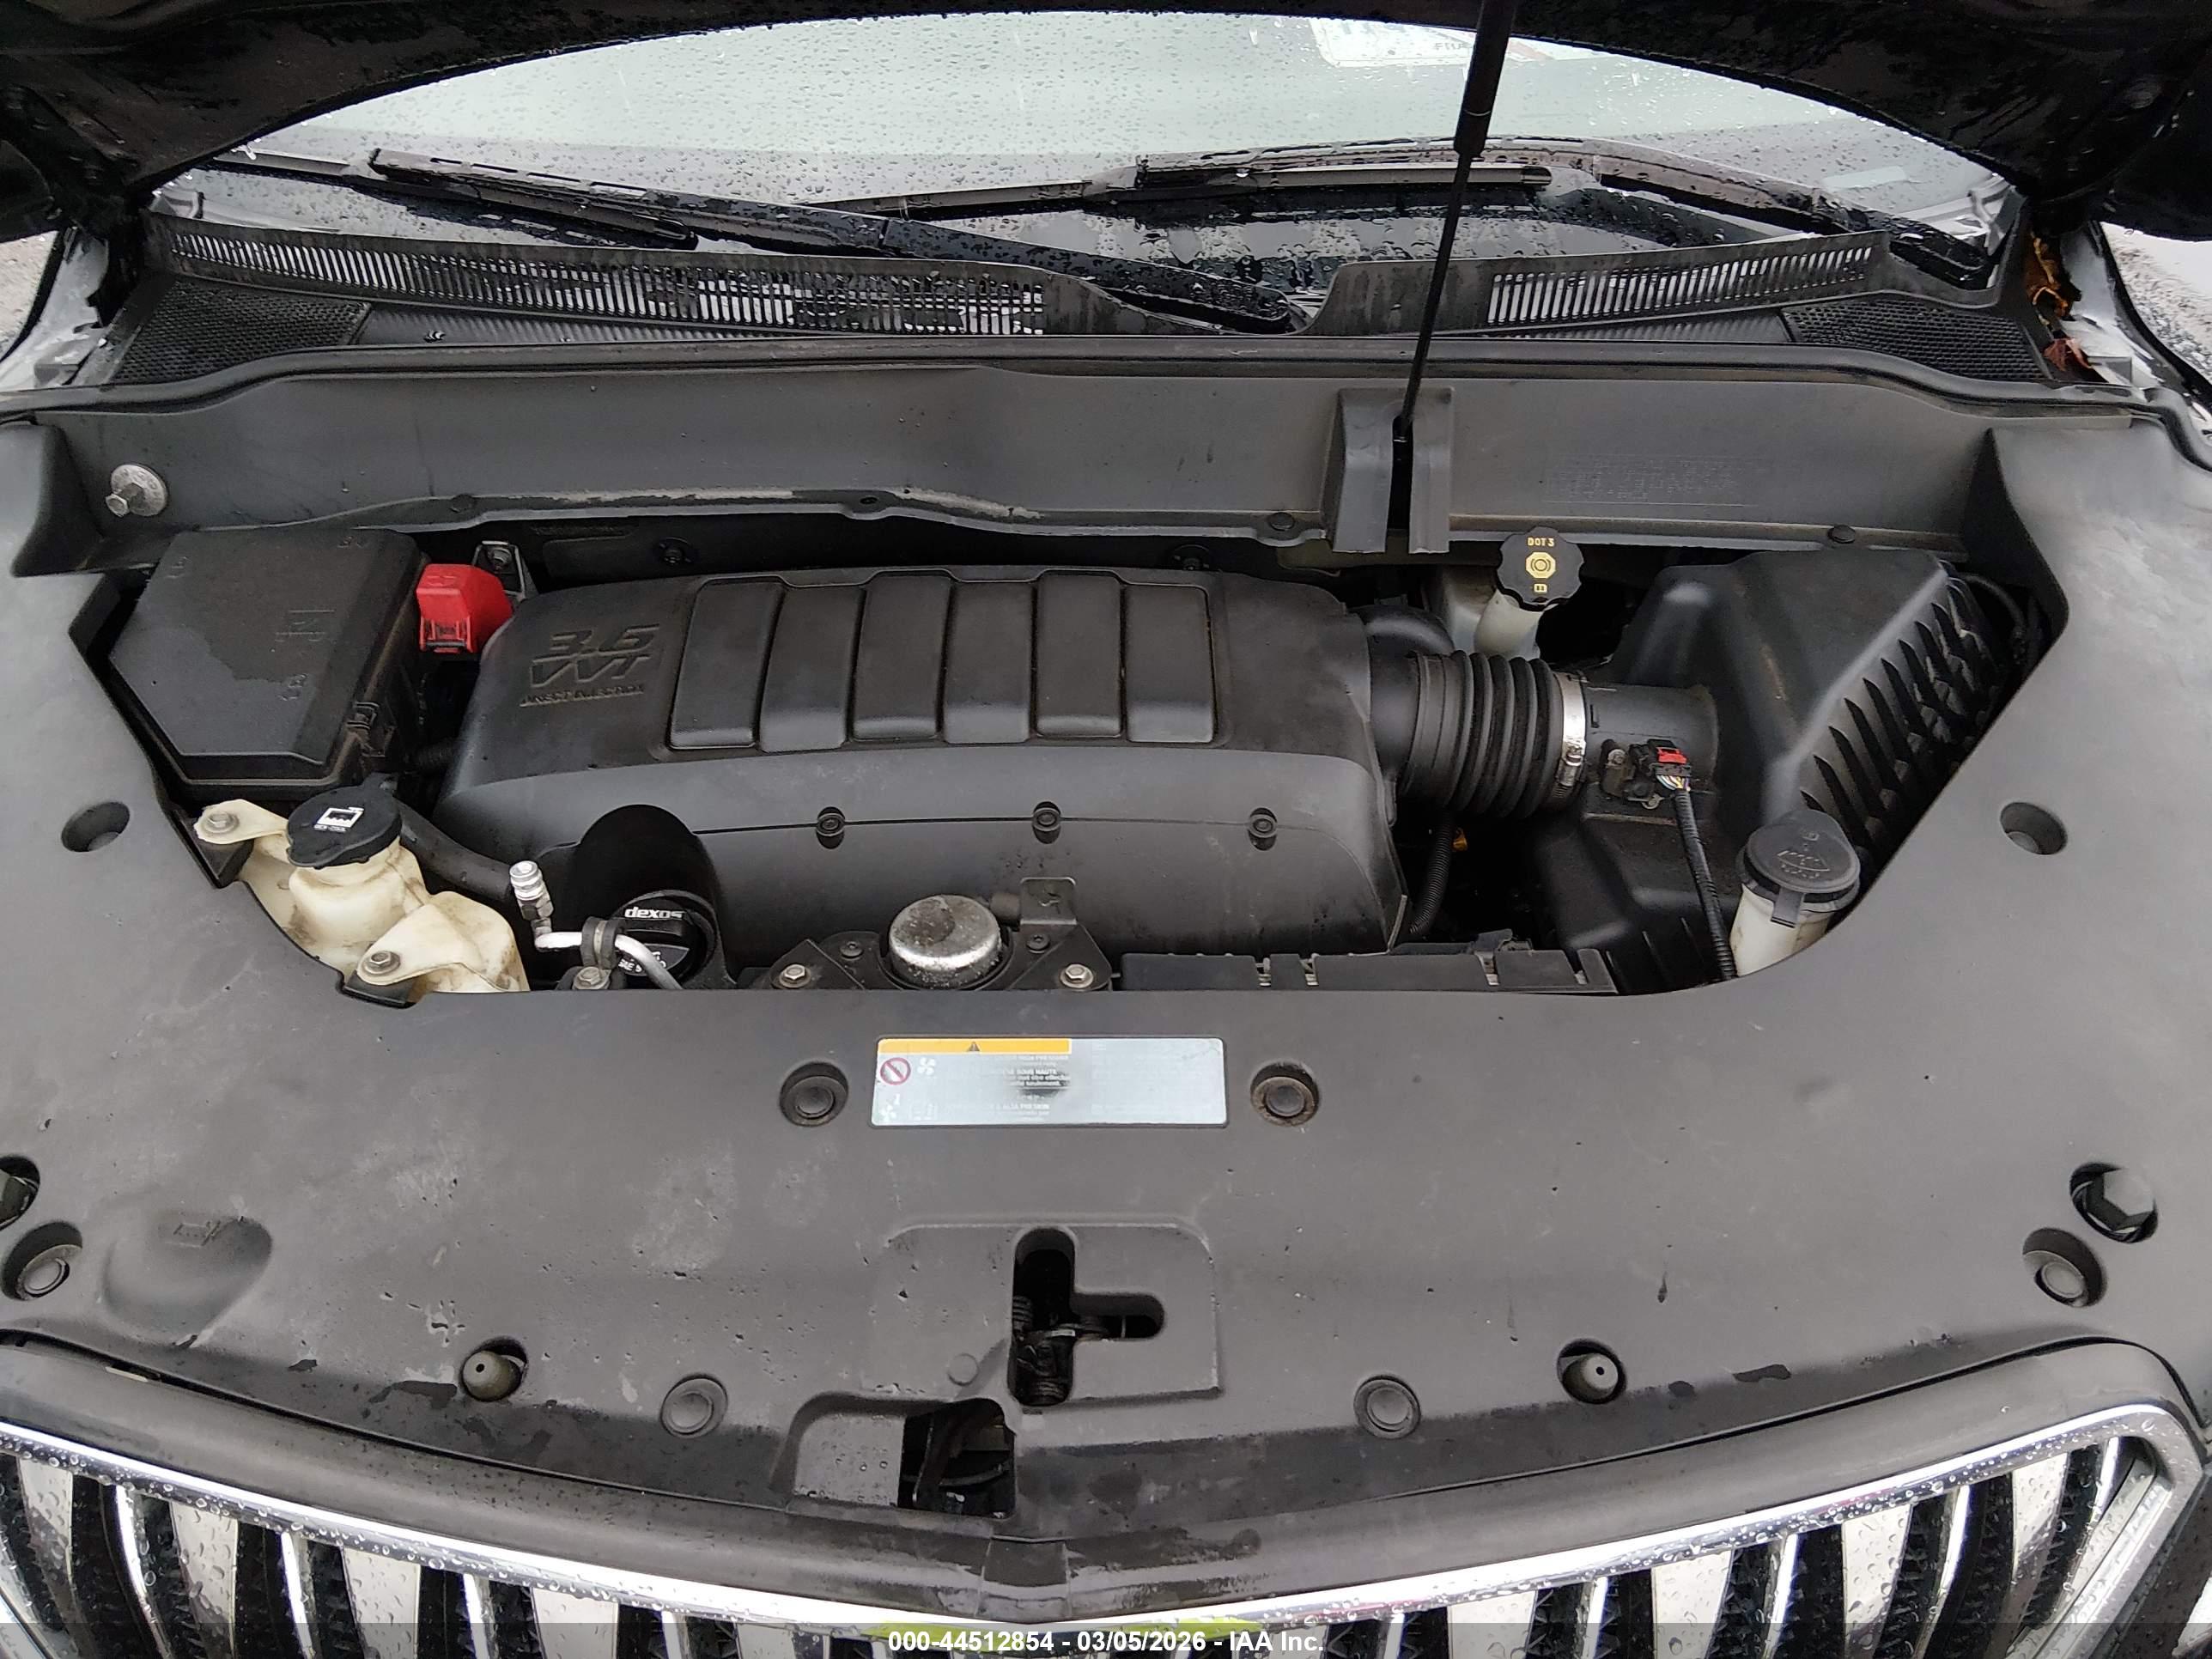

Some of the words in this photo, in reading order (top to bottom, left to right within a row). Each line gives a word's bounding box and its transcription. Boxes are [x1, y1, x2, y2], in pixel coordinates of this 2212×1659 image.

[1528, 538, 1547, 546] DOT
[1547, 538, 1555, 547] 3
[530, 653, 652, 688] VVT
[624, 907, 684, 919] dexos
